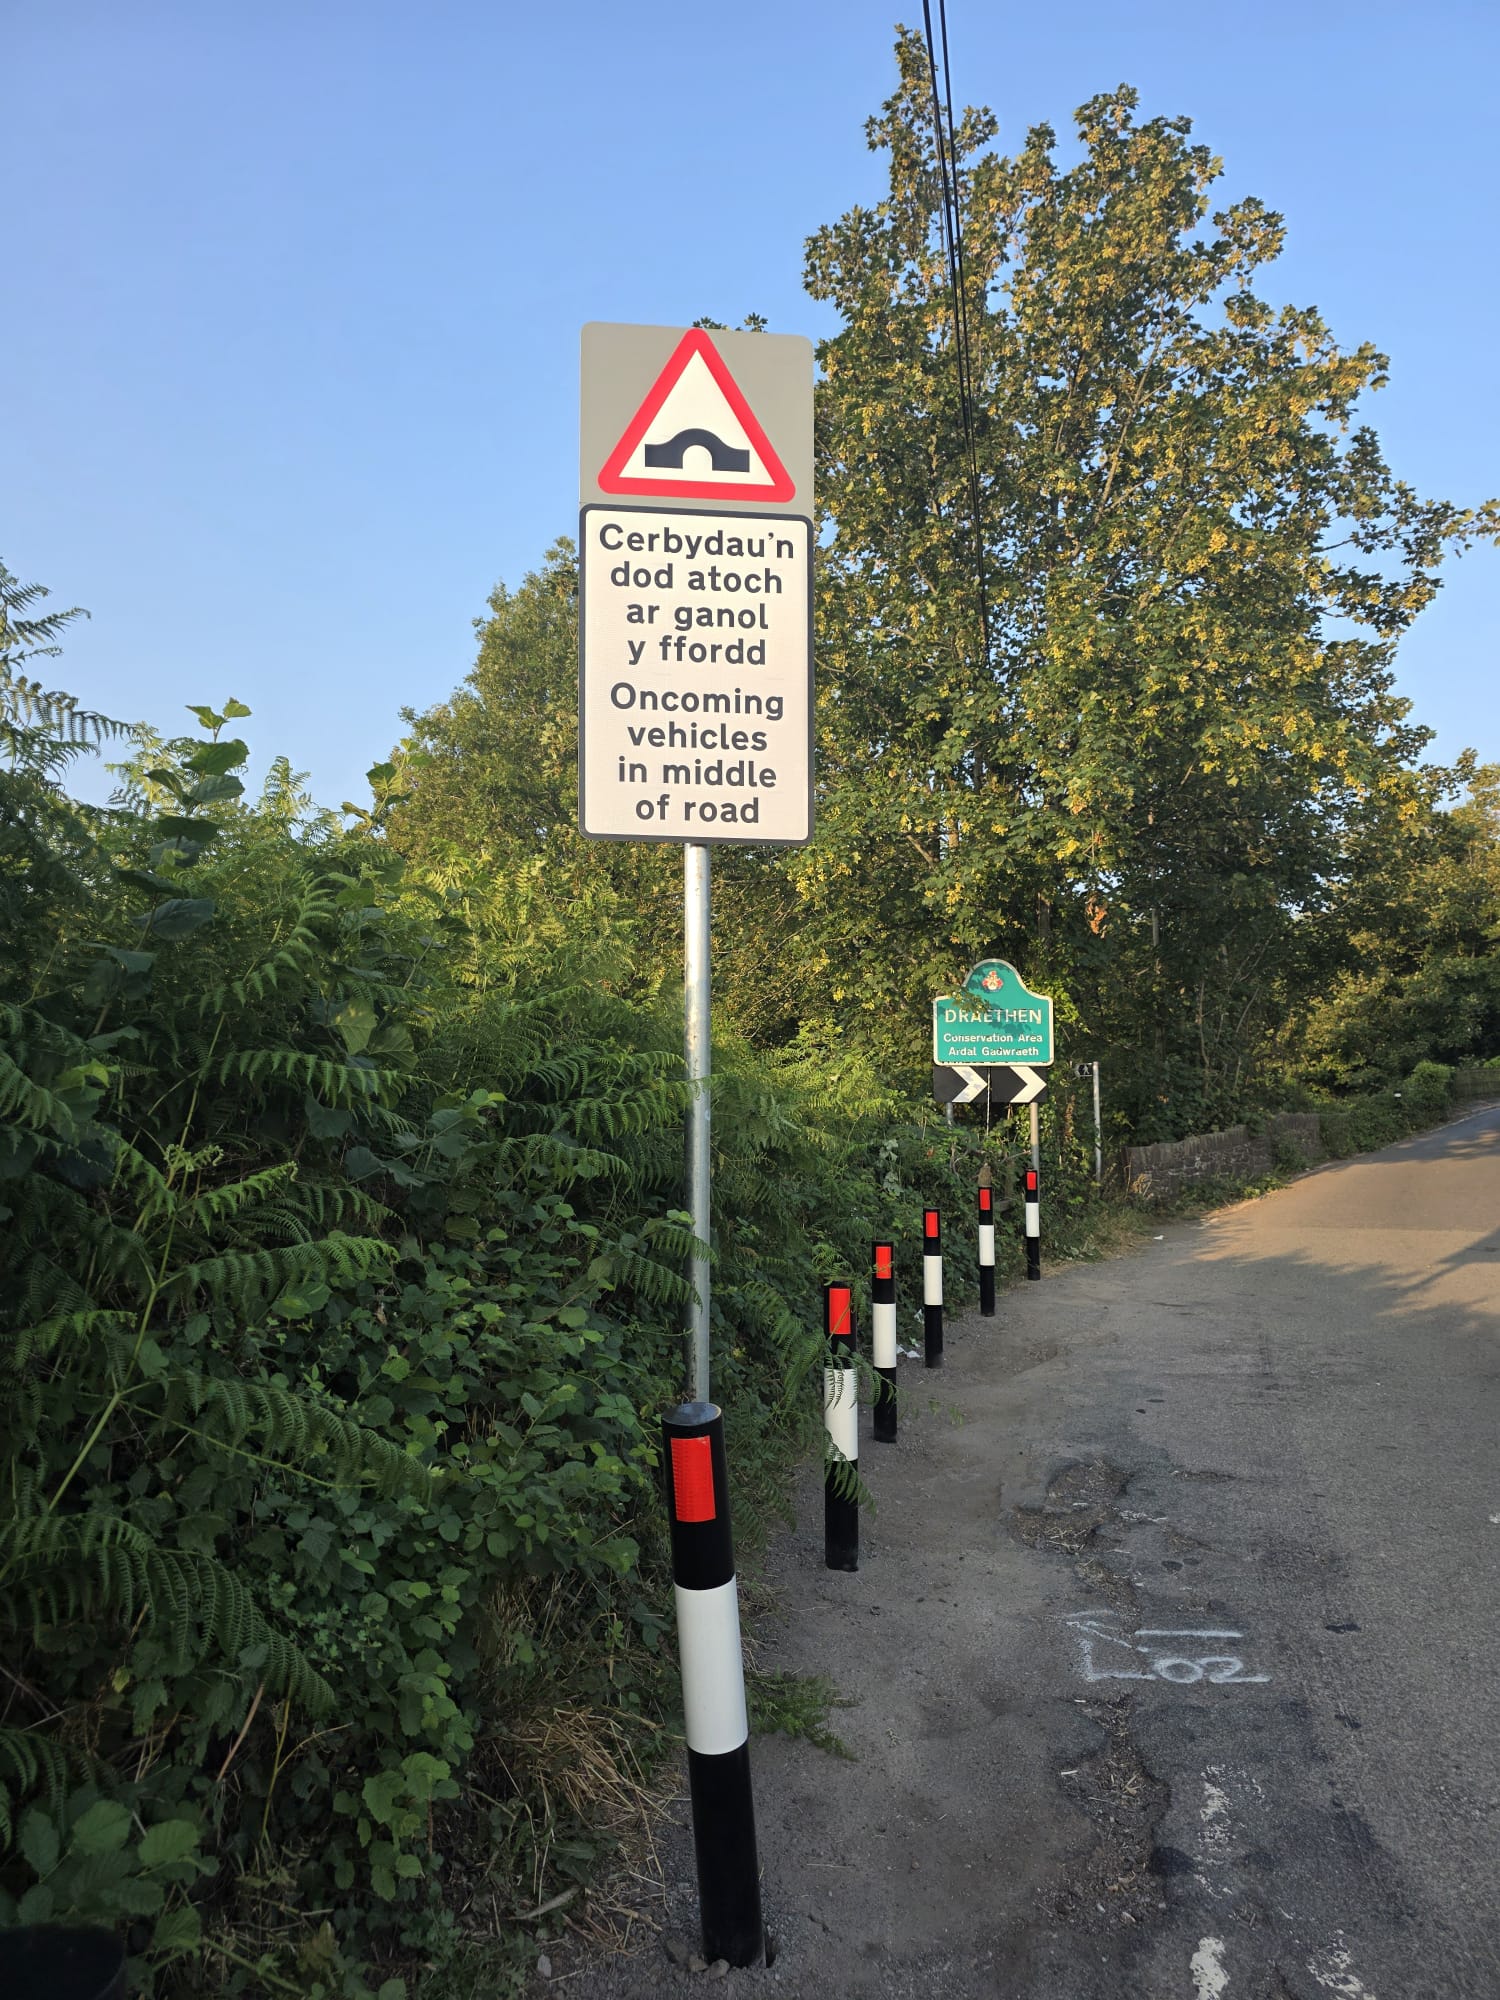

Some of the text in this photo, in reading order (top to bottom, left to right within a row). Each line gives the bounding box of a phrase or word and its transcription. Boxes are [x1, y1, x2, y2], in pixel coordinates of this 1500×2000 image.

[599, 523, 794, 560] Cerbydau'n
[610, 560, 782, 594] dod atoch
[626, 603, 769, 631] ar ganol
[627, 634, 766, 666] y ffordd
[610, 682, 784, 721] Oncoming
[627, 721, 768, 751] vehicles
[618, 755, 777, 788] in middle
[635, 793, 759, 824] of road
[944, 1008, 1042, 1024] DRAETHEN
[943, 1033, 1043, 1043] Conservation Area
[948, 1046, 1039, 1056] Ardal Gadwraeth
